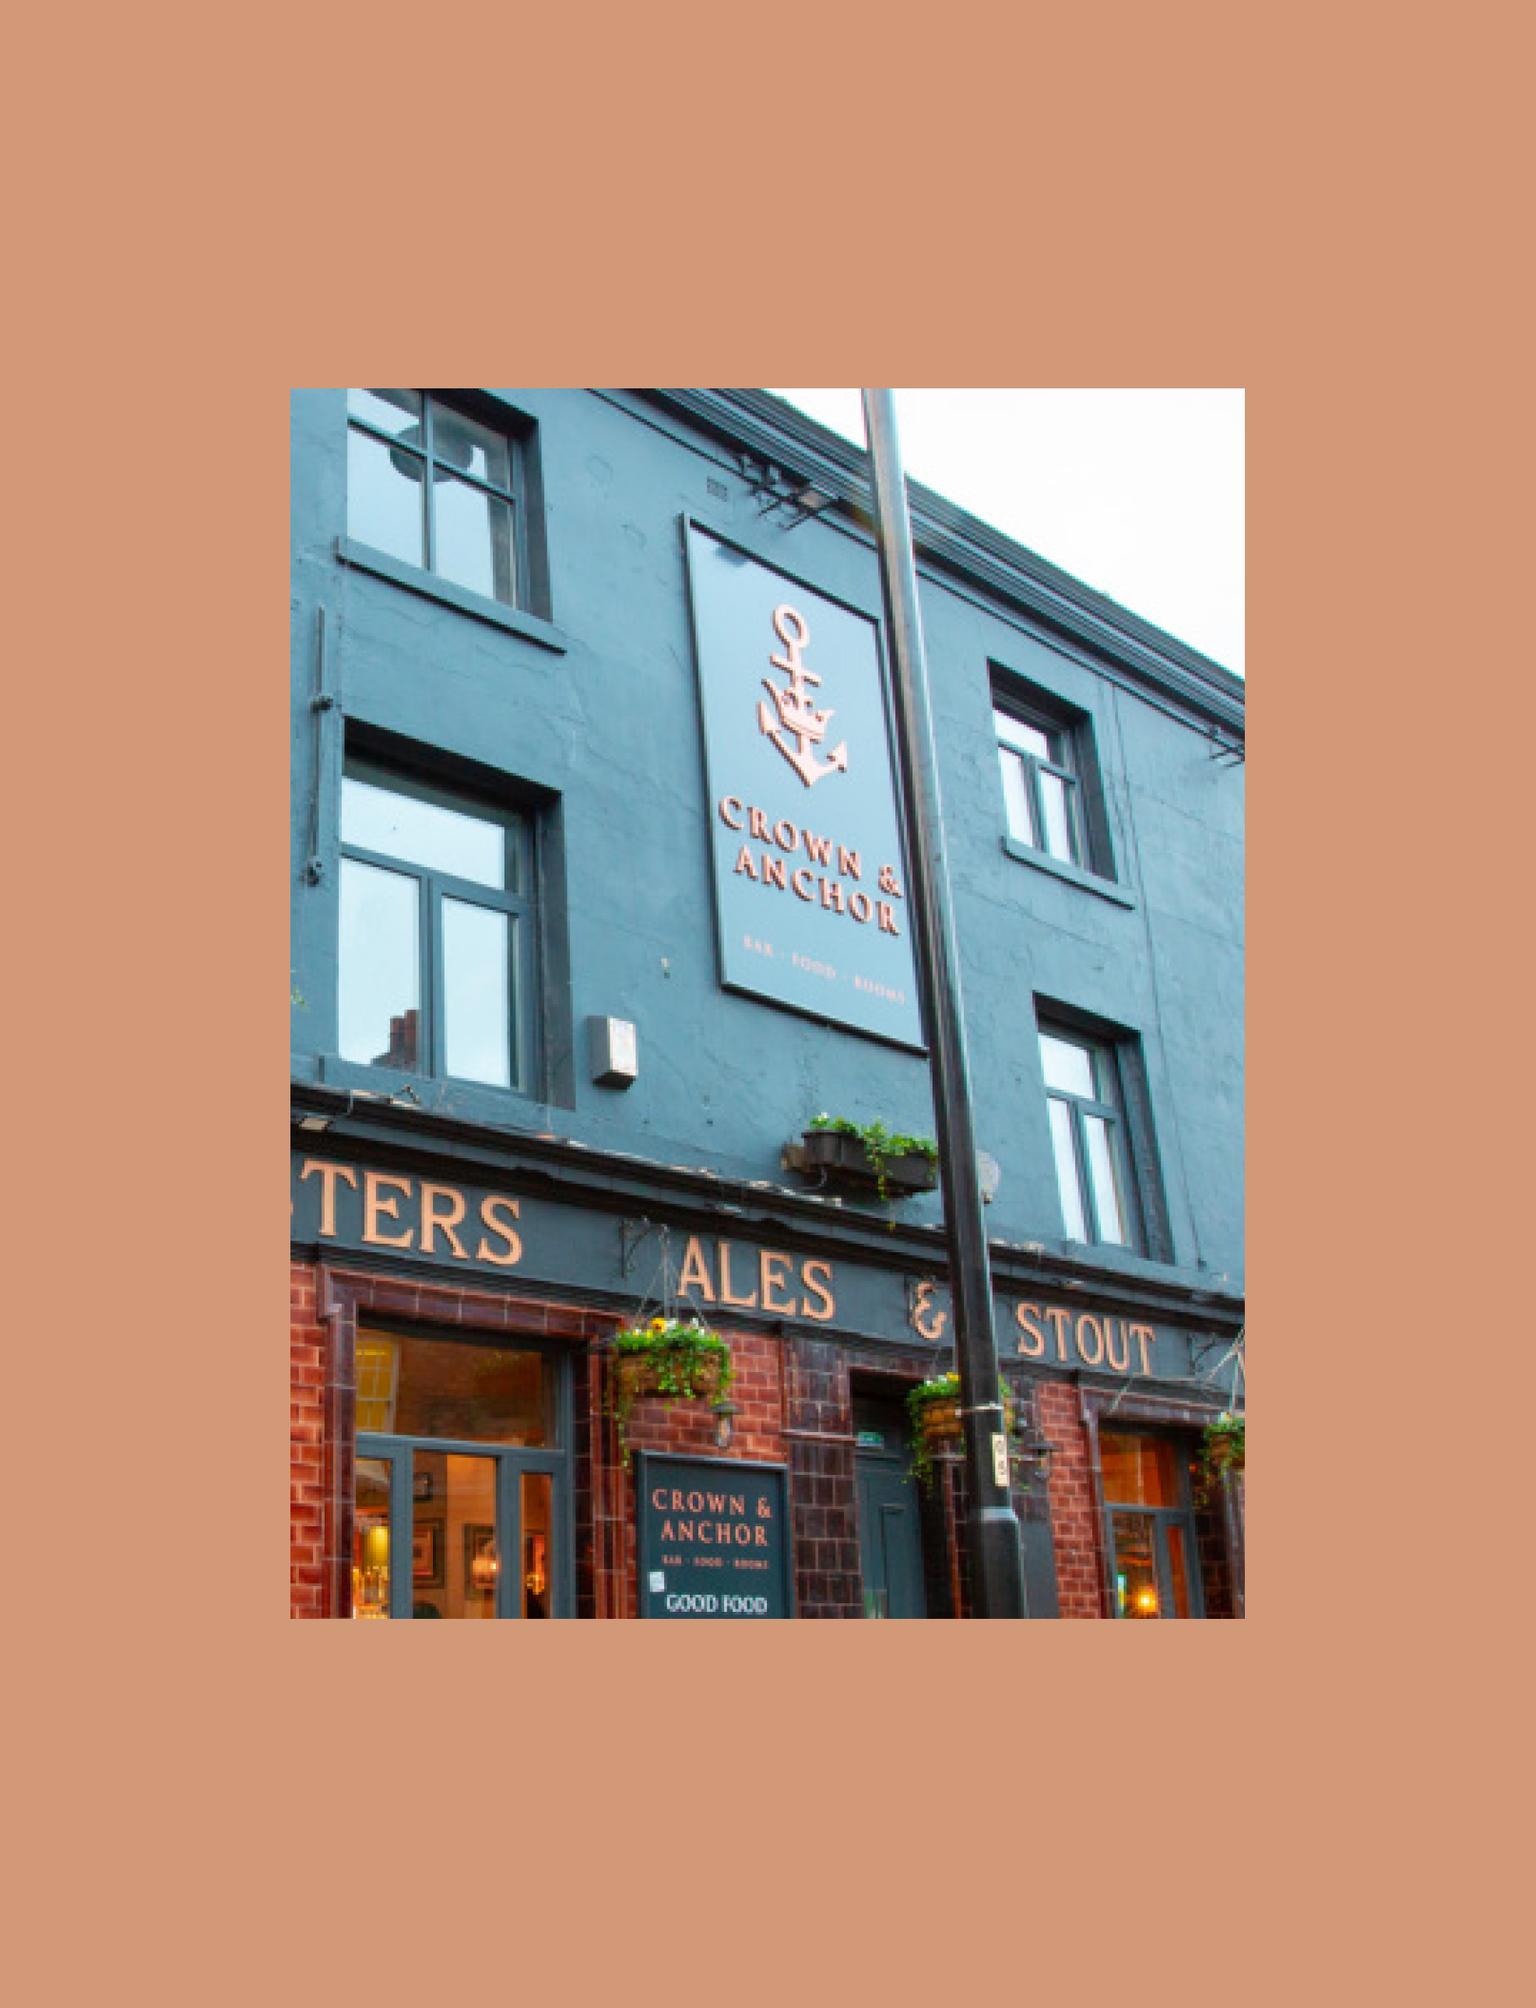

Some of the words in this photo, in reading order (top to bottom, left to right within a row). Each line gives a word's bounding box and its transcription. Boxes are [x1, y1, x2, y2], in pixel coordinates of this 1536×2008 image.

[719, 796, 861, 881] CROWN
[877, 864, 903, 898] &
[733, 844, 901, 936] ANCHOR
[792, 951, 837, 982] FOOD
[290, 1159, 523, 1266] TERS
[676, 1235, 836, 1320] ALES
[911, 1280, 947, 1340] &
[1015, 1302, 1156, 1375] STOUT
[652, 1488, 745, 1515] CROWN
[757, 1497, 772, 1519] &
[661, 1519, 768, 1547] ANCHOR
[666, 1594, 718, 1613] GOOD
[722, 1595, 768, 1614] FOOD
